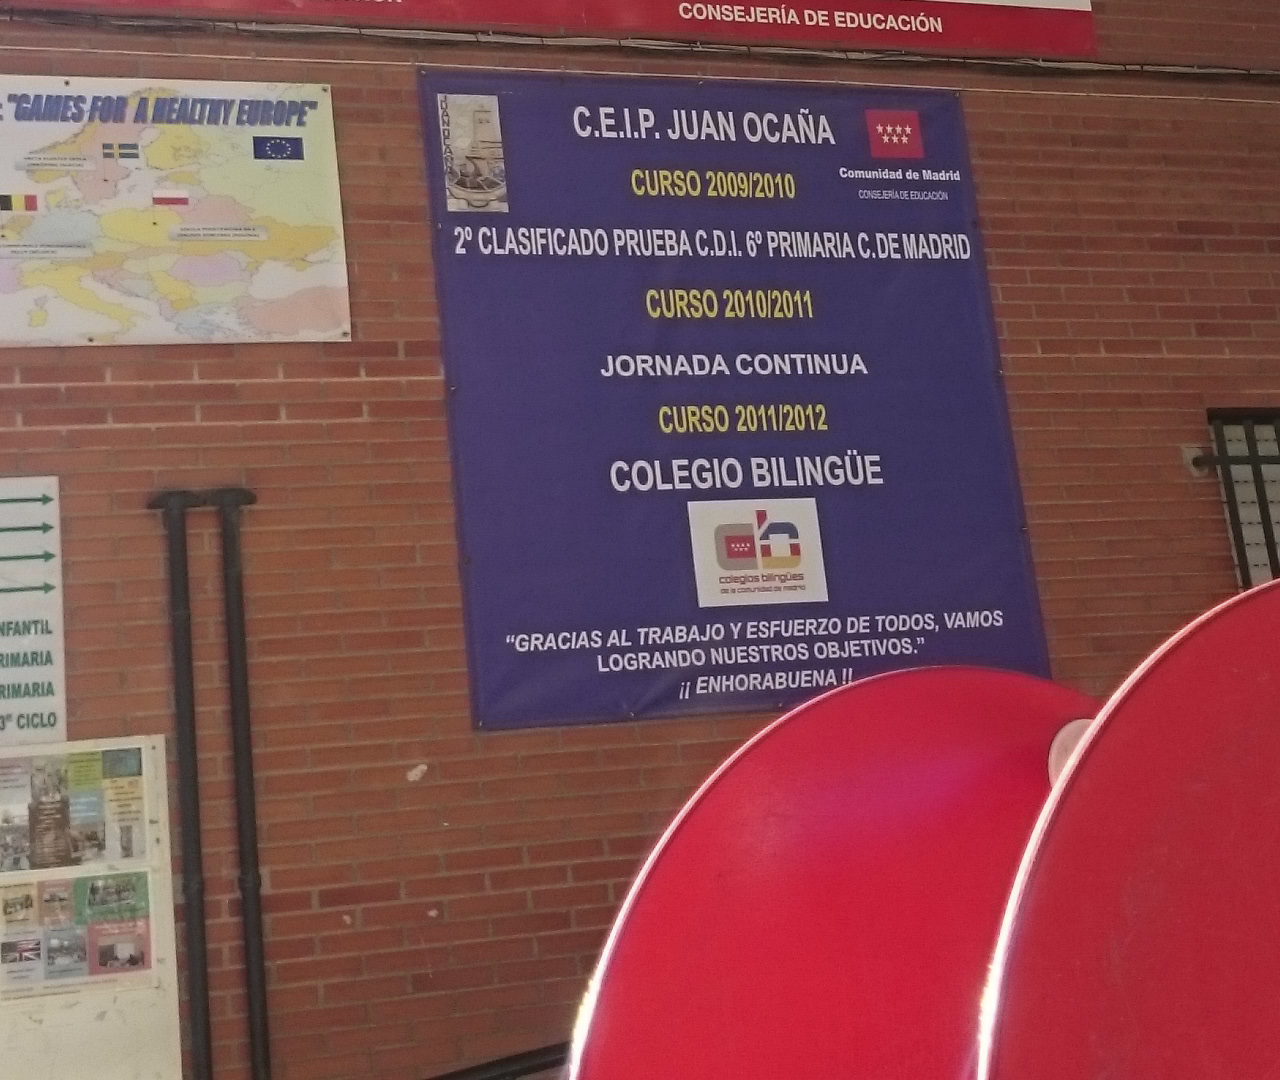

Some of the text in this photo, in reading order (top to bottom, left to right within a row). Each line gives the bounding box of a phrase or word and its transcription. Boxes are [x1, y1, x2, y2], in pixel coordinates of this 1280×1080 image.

[679, 2, 943, 33] CONSEJERÍA DE EDUCACIÓN
[88, 95, 129, 123] FOR
[133, 97, 150, 124] A
[152, 97, 236, 126] HEALTHY
[573, 106, 836, 145] C.E.I.P. JUAN OCAÑA
[630, 168, 796, 200] CURSO 2009/2010
[839, 167, 961, 181] Comunidad de Madrid
[858, 189, 900, 200] CONSEJERÍA
[900, 190, 909, 200] DE
[478, 227, 609, 257] CLASIFICADO
[613, 228, 693, 258] PRUEBA
[695, 229, 743, 258] C.D.I.
[767, 230, 856, 259] PRIMARIA
[902, 233, 972, 260] MADRID
[646, 289, 813, 319] CURSO 2010/2011
[600, 353, 868, 377] JORNADA CONTINUA
[658, 404, 828, 434] CURSO 2011/2012
[610, 450, 884, 492] COLEGIO BILINGÜE
[607, 630, 632, 648] AL
[636, 624, 725, 647] TRABAJO
[729, 623, 743, 639] Y
[746, 618, 842, 639] ESFUERZO
[846, 617, 870, 634] DE
[875, 613, 940, 633] TODOS,
[944, 610, 1004, 628] VAMOS
[597, 650, 706, 672] LOGRANDO
[710, 645, 810, 666] NUESTROS
[695, 670, 838, 695] ENHORABUENA
[17, 712, 57, 729] CICLO
